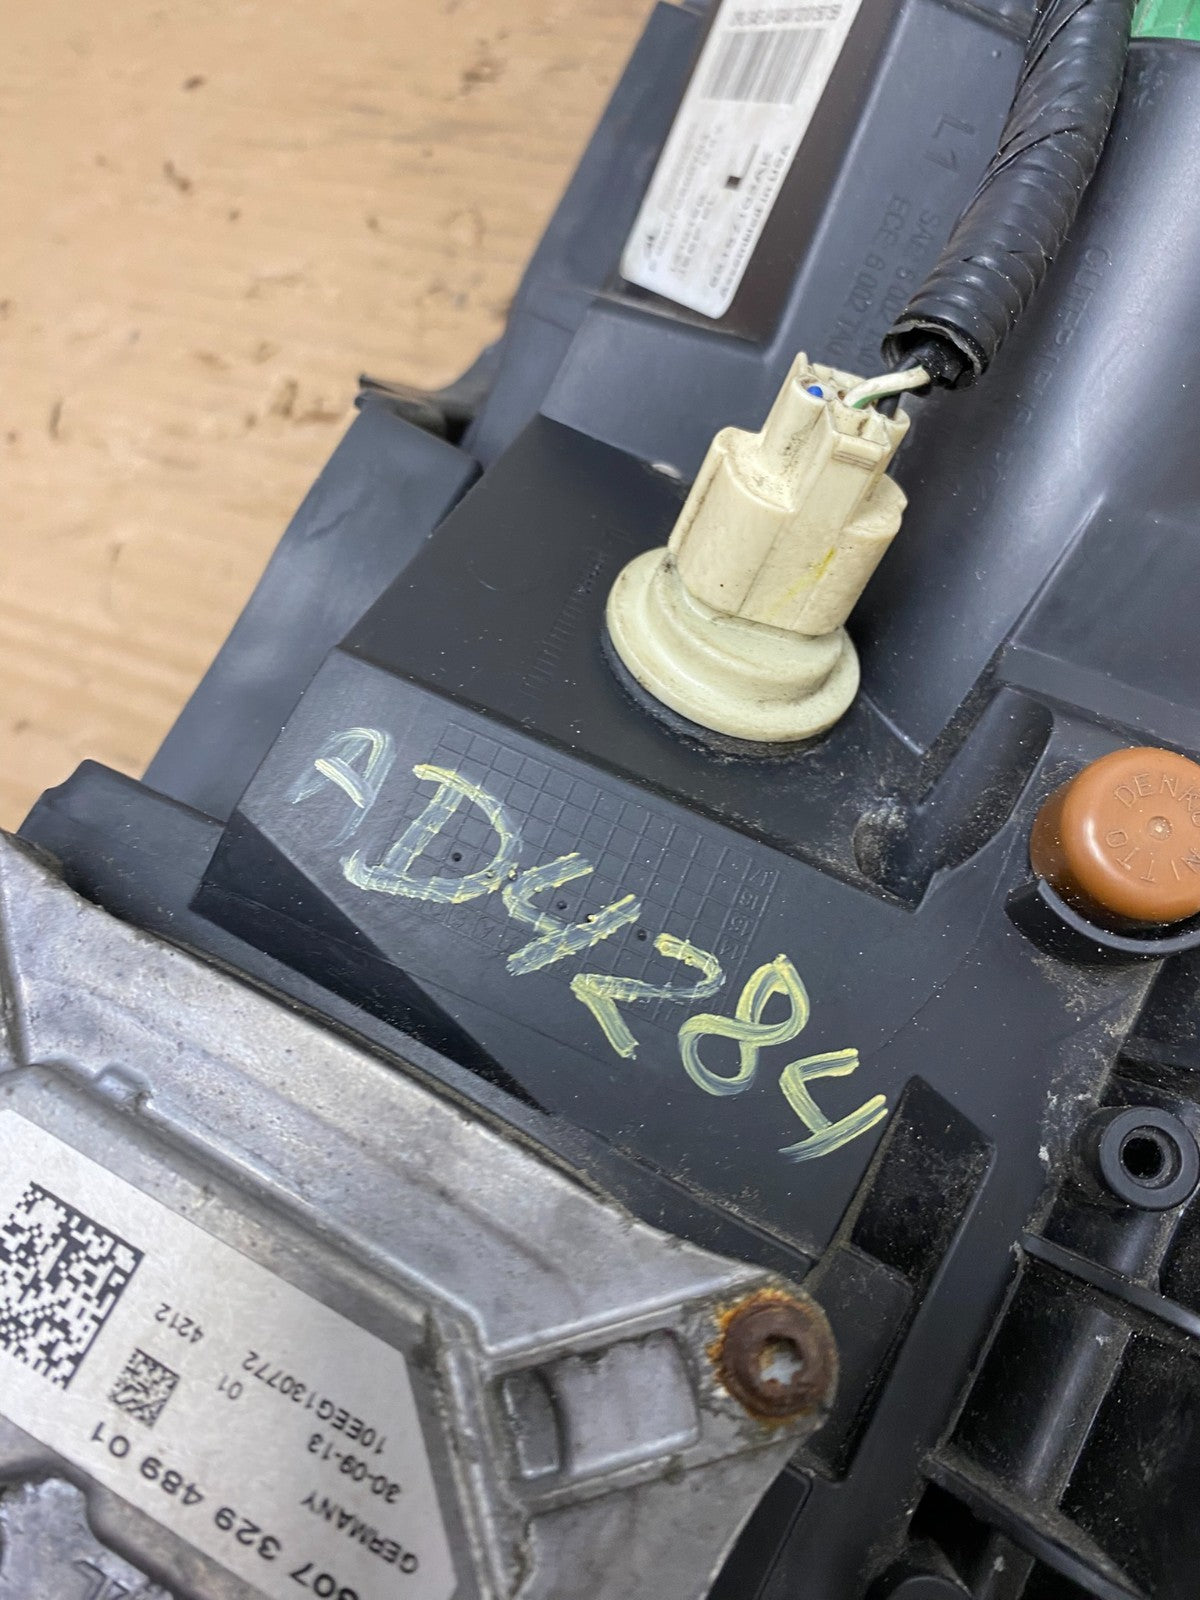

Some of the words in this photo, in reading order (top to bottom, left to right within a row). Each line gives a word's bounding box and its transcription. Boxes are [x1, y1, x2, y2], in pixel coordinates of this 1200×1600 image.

[292, 727, 889, 1163] AD4284
[155, 1303, 204, 1343] 4212
[218, 1375, 243, 1400] 01
[243, 1352, 386, 1454] 10EEG130772
[91, 1422, 130, 1458] 01
[140, 1457, 204, 1505] 489
[308, 1434, 400, 1504] 30-09-13
[215, 1507, 283, 1561] 329
[300, 1494, 419, 1576] GERMANY
